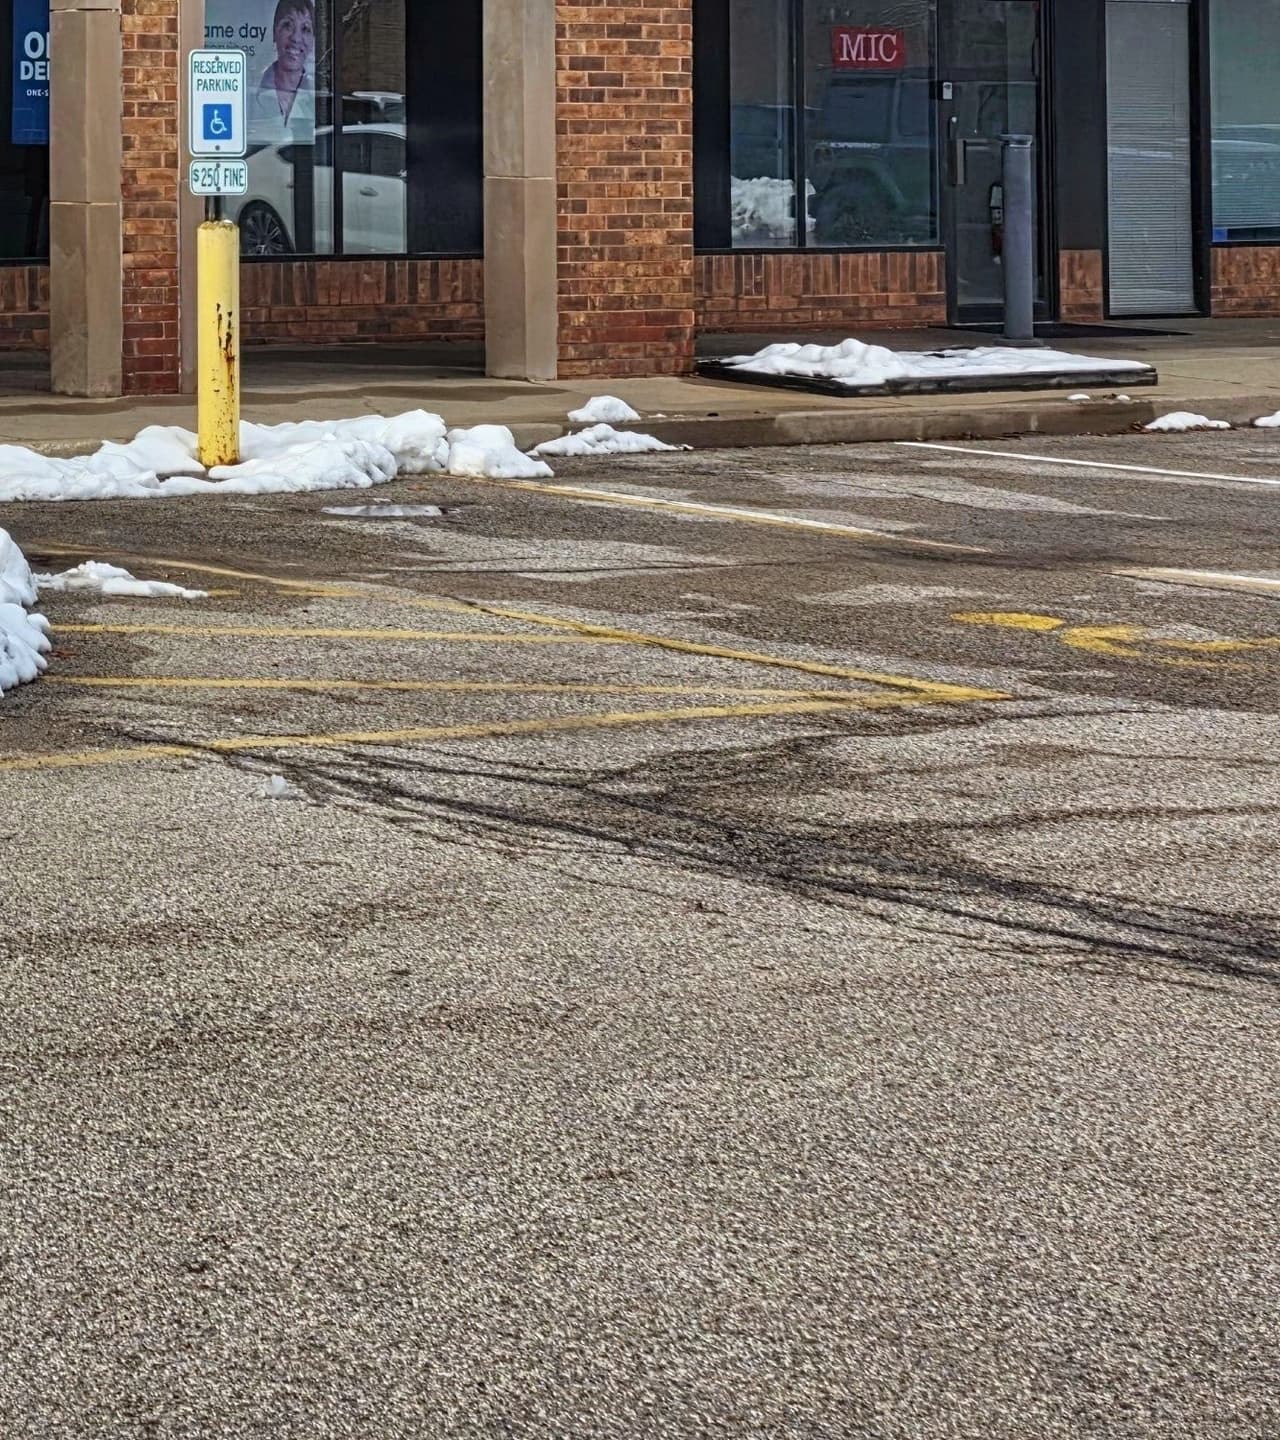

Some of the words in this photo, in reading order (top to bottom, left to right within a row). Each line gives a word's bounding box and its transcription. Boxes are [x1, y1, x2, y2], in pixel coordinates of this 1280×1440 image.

[239, 22, 267, 42] day
[840, 33, 897, 62] MIC
[193, 61, 241, 74] RESERVED
[197, 79, 239, 92] PARKING
[193, 167, 220, 187] $250
[224, 168, 244, 187] FINE
